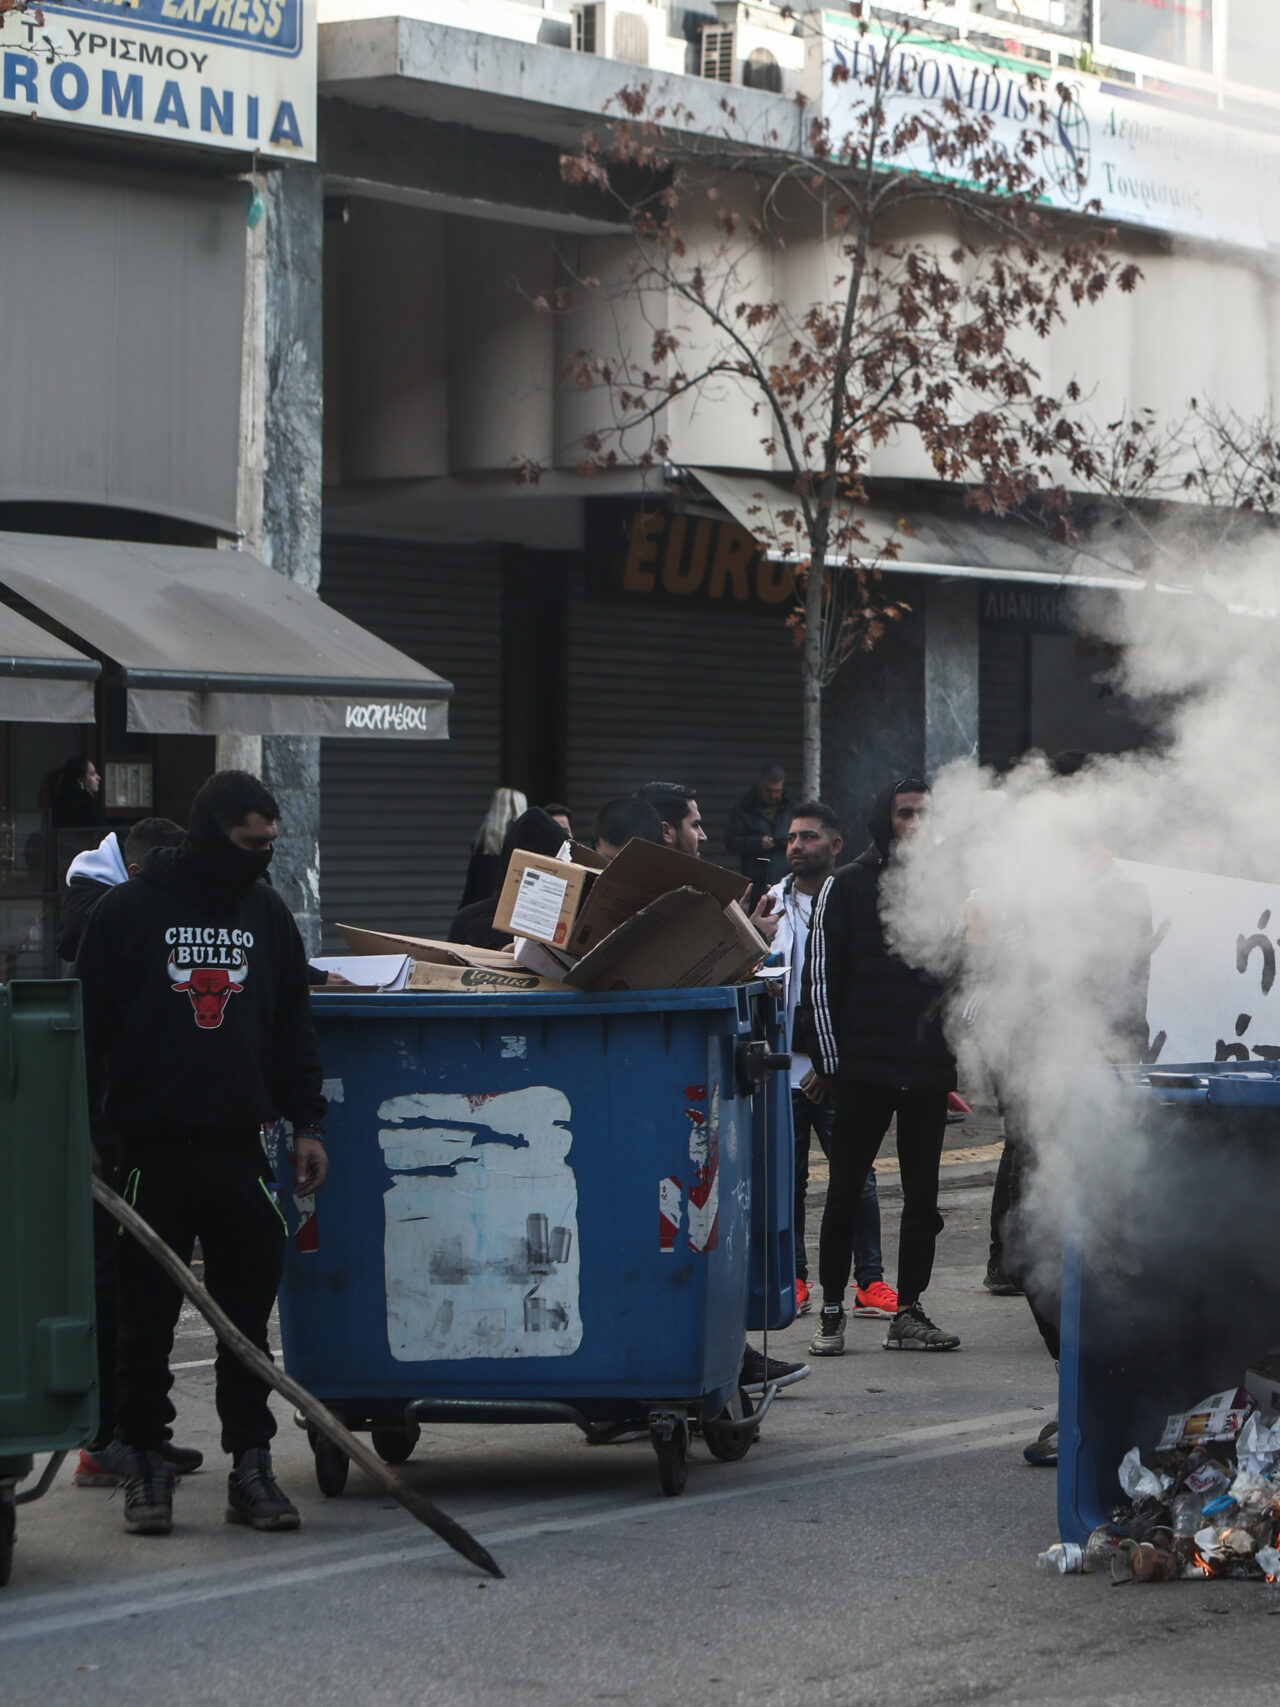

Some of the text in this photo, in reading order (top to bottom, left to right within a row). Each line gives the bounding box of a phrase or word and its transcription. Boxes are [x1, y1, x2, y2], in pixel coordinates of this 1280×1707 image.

[3, 52, 303, 148] ROMANIA
[164, 926, 255, 949] CHICAGO
[177, 946, 242, 966] BULLS
